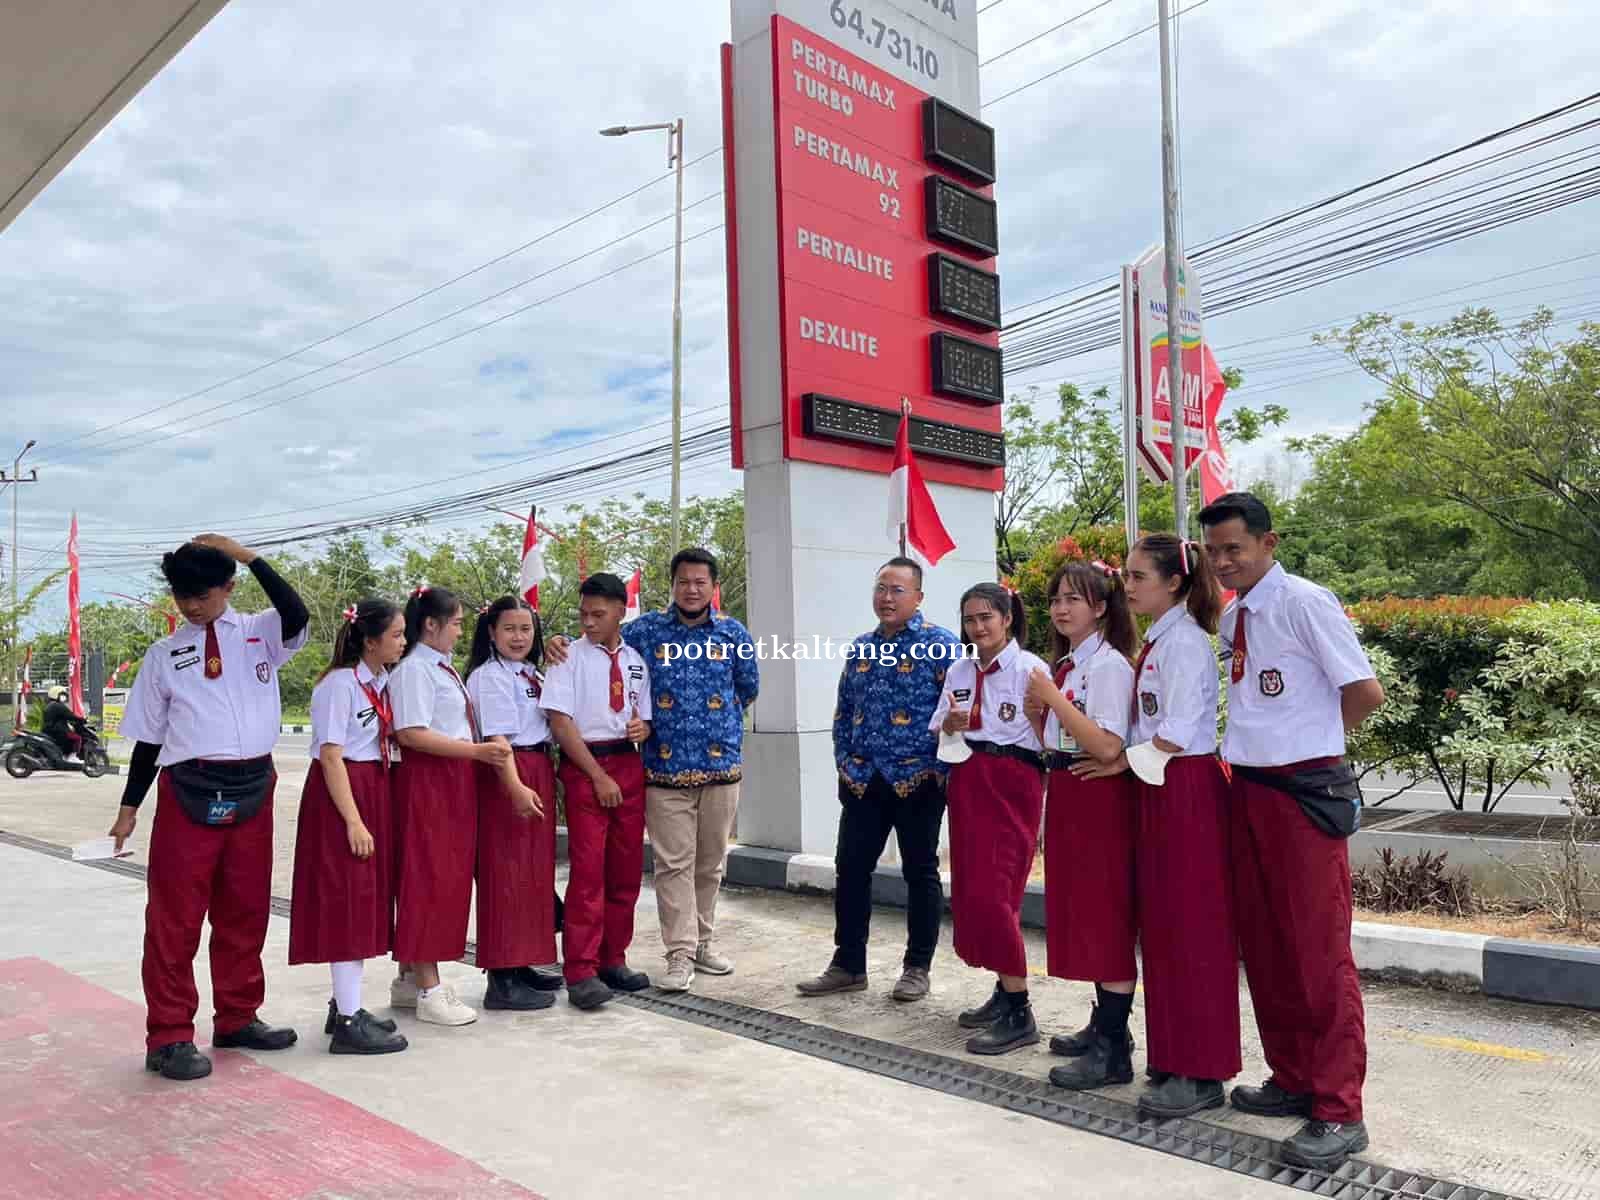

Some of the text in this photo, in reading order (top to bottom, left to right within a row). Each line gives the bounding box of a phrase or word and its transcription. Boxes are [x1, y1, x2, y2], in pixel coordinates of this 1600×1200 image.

[830, 0, 940, 80] 64.731.10
[791, 38, 897, 110] PERTAMAX
[793, 70, 854, 116] TURBO
[793, 126, 899, 189] PERTAMAX
[879, 193, 901, 218] 92
[797, 226, 893, 280] PERTALITE
[800, 316, 878, 357] DEXLITE
[1155, 366, 1201, 409] AM
